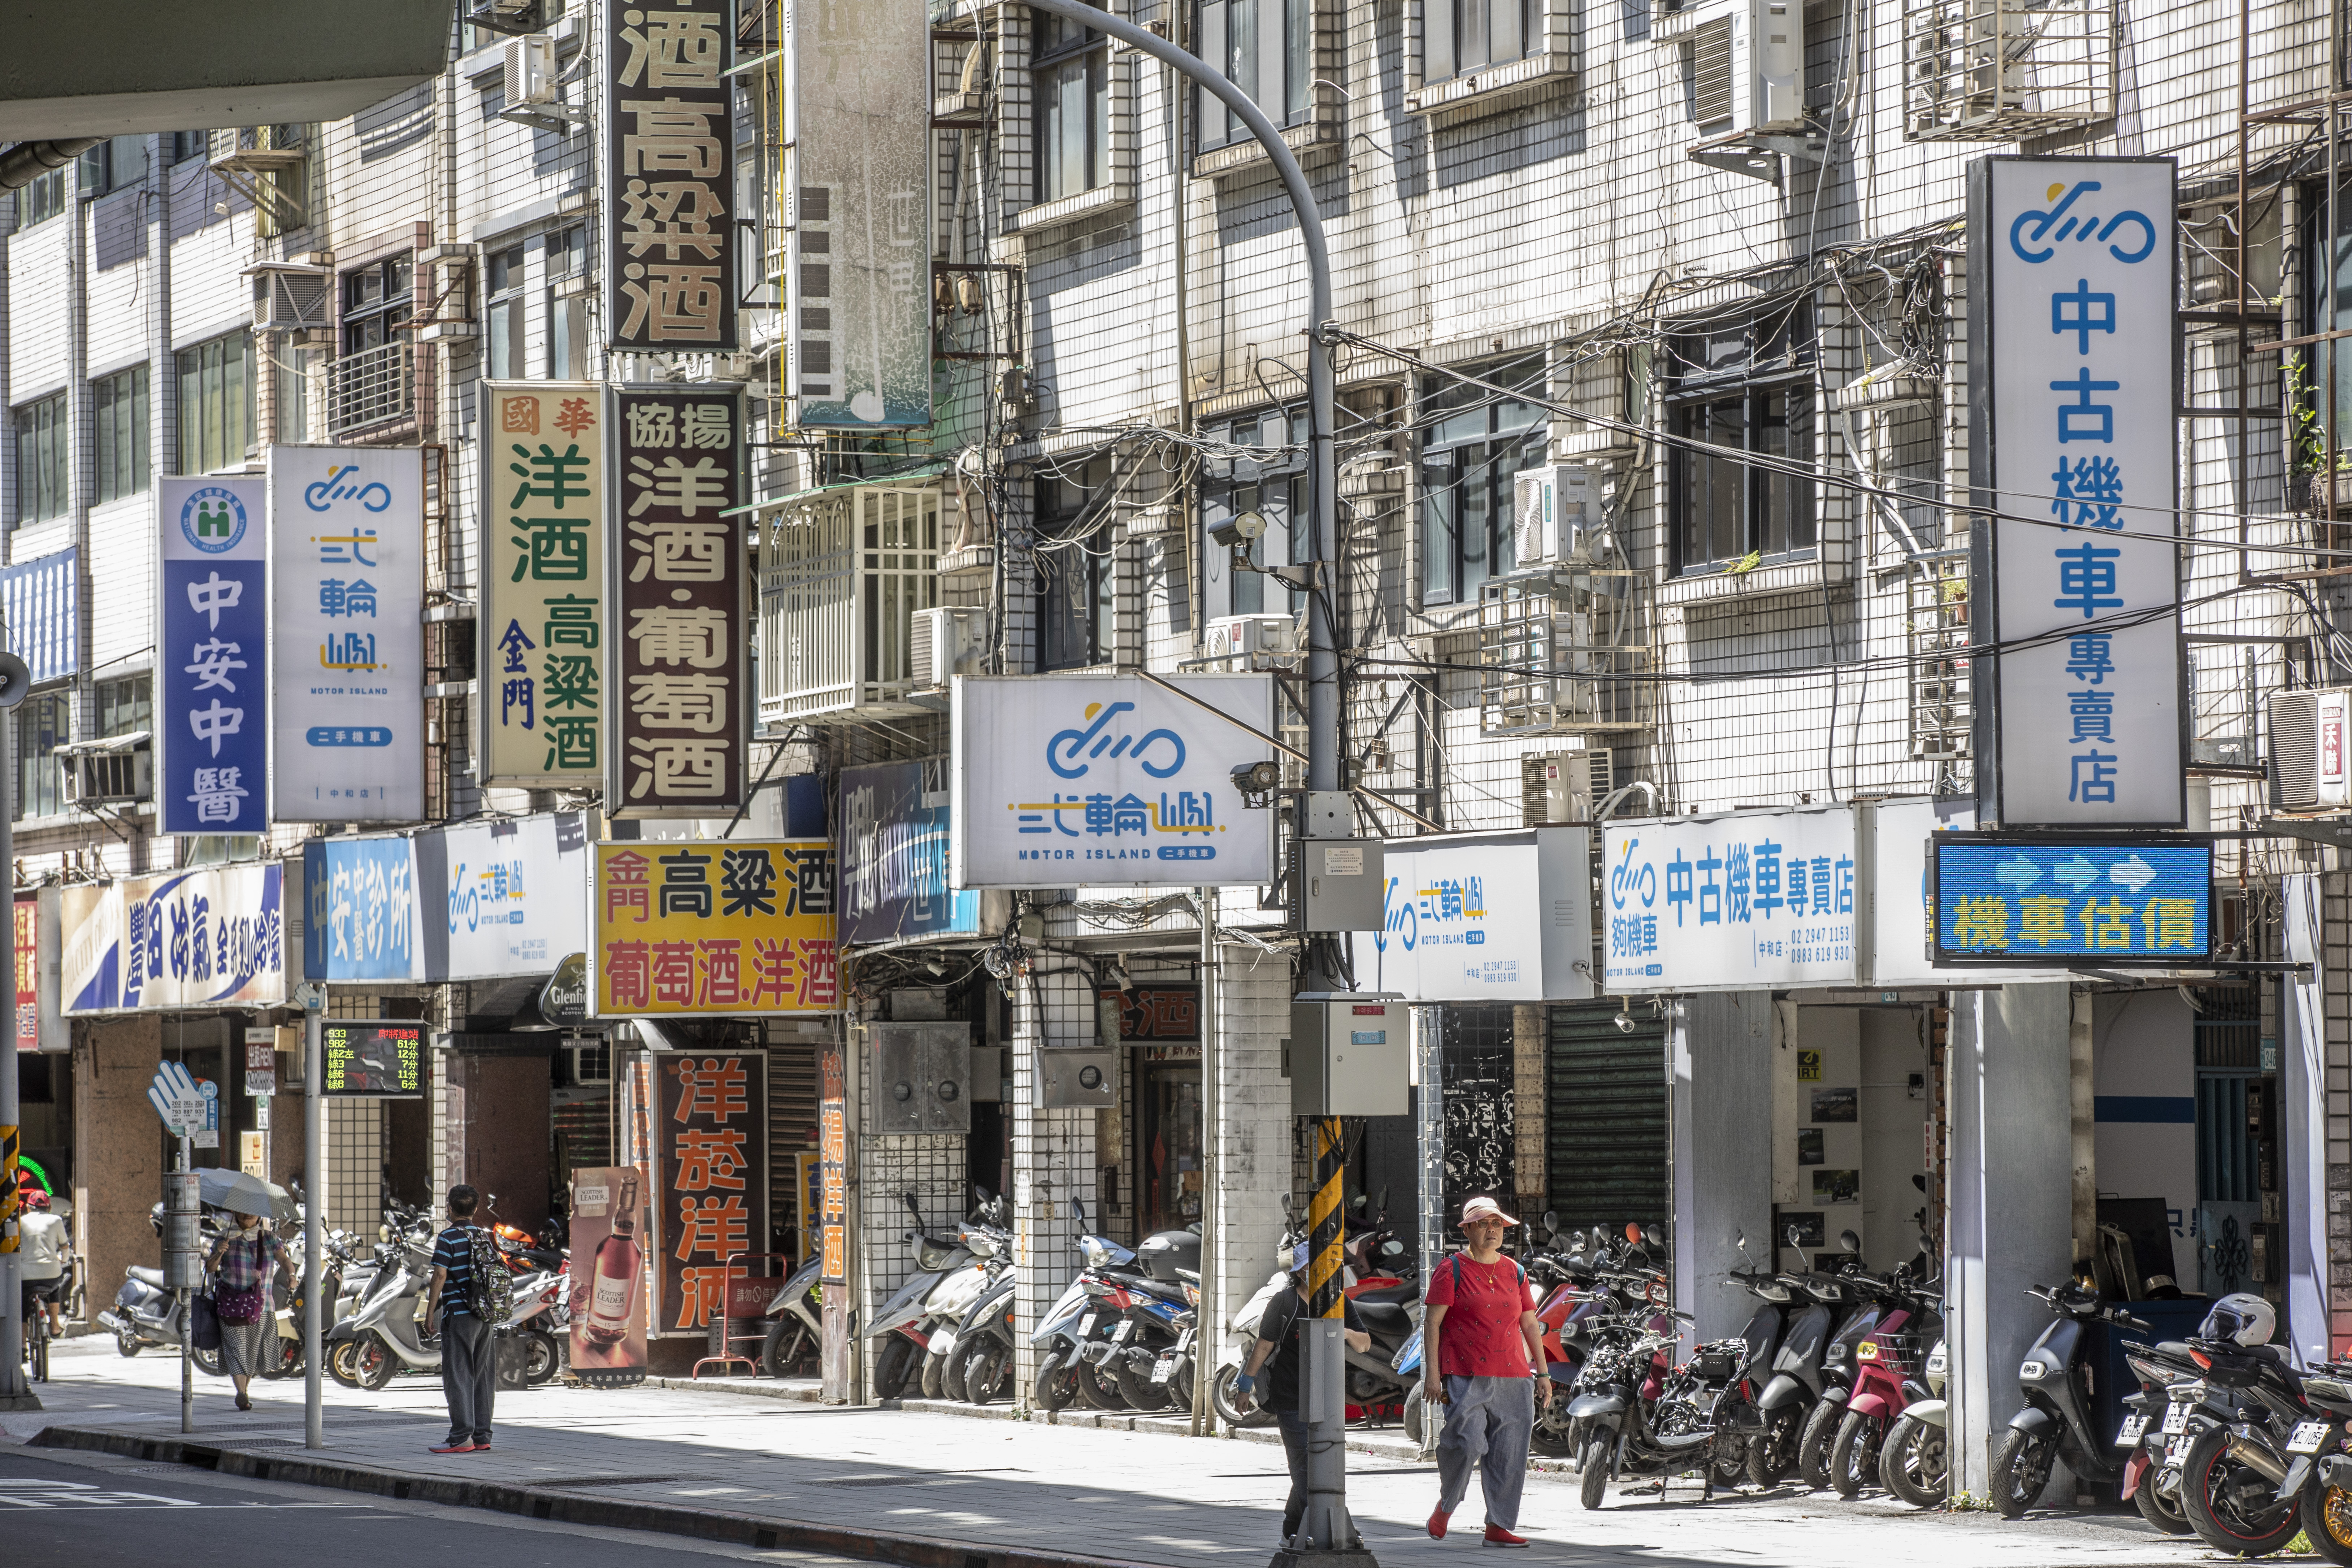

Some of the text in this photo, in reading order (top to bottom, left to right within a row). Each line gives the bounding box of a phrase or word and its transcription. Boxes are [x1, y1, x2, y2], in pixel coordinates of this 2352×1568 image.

[618, 0, 725, 341] 酒高粱酒
[625, 402, 731, 450] 協揚
[509, 443, 591, 583] 洋酒
[183, 518, 197, 545] NATIONAL
[226, 518, 244, 548] INSURANCE
[2049, 278, 2125, 804] 中古機車專賣店
[497, 618, 537, 730] 金門
[543, 593, 599, 772] 高粱酒
[184, 571, 249, 823] 中安中醫
[318, 731, 382, 743] 二手機車
[2325, 724, 2338, 774] 禾聯
[330, 789, 368, 799] 中和店
[1019, 849, 1151, 860] MOTOR ISLAND
[1165, 848, 1209, 858] 二手機車
[606, 850, 650, 923] 金門
[1667, 837, 1854, 928] 中古機車專賣店
[481, 914, 508, 925] MOTOR ISLAND
[1953, 894, 2197, 950] 機車估價
[1421, 933, 1464, 945] MOTOR ISLAND
[1792, 926, 1849, 944] 02 2947 1153
[1791, 945, 1849, 964] 0983 619 930
[1483, 960, 1516, 972] 02 2947 1153
[1607, 967, 1644, 977] MOTOR ISLAND
[1484, 972, 1516, 983] 0983 619 930
[328, 1029, 346, 1038] 933
[378, 1029, 418, 1039] 即將進站
[328, 1039, 346, 1048] 982
[397, 1039, 418, 1049] 61分
[398, 1050, 418, 1059] 12分
[328, 1059, 344, 1069] 綠3
[402, 1060, 418, 1069] 7分
[328, 1069, 344, 1079] 綠6
[398, 1070, 418, 1080] 11分
[402, 1080, 418, 1090] 6分
[597, 1292, 625, 1304] LEADER
[599, 1288, 624, 1297] SCOTTISH
[736, 1288, 752, 1302] 請勿
